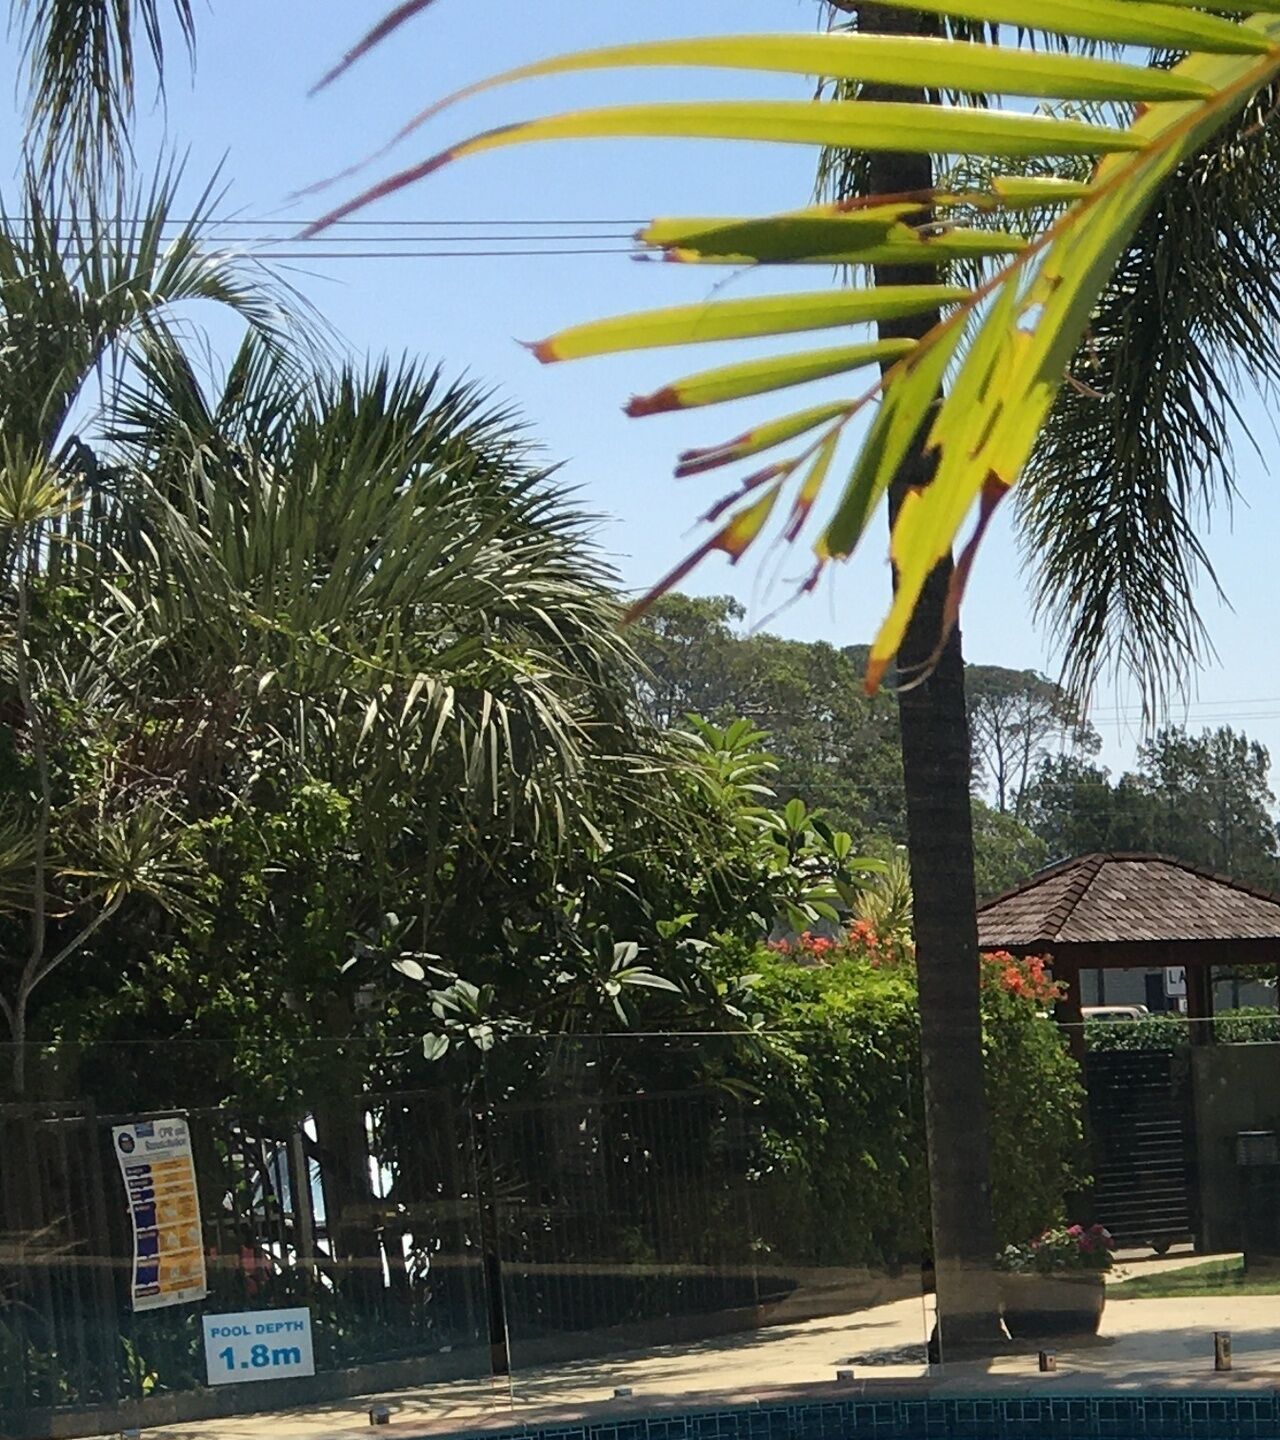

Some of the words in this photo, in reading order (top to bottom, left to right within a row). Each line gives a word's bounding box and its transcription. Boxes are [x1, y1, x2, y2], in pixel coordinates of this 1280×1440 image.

[210, 1324, 250, 1338] POOL
[255, 1320, 304, 1334] DEPTH
[219, 1344, 300, 1370] 1.8m
